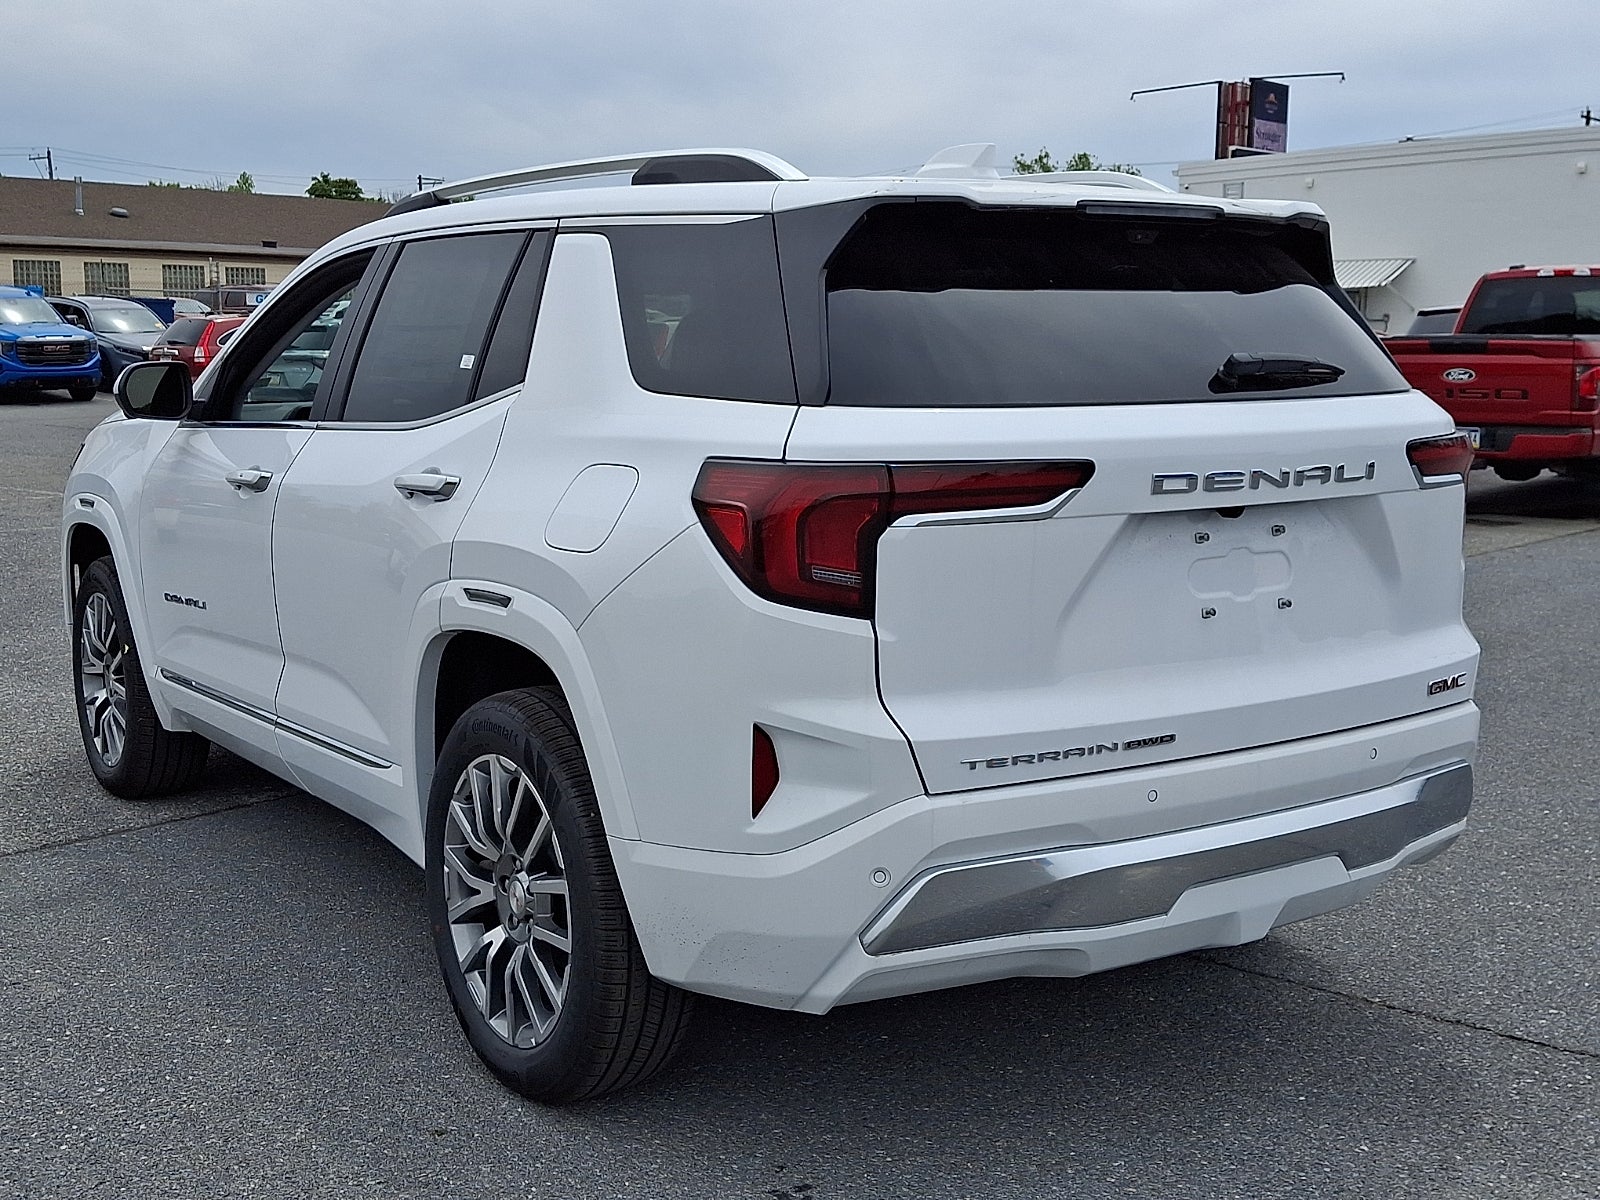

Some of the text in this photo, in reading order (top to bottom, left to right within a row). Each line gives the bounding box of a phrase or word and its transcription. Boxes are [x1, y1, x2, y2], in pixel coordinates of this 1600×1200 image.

[1151, 460, 1376, 495] DENALI
[163, 592, 207, 610] DENALI
[1427, 672, 1467, 696] GMC
[471, 717, 514, 743] Continental
[960, 733, 1176, 770] TERRAIN AWD
